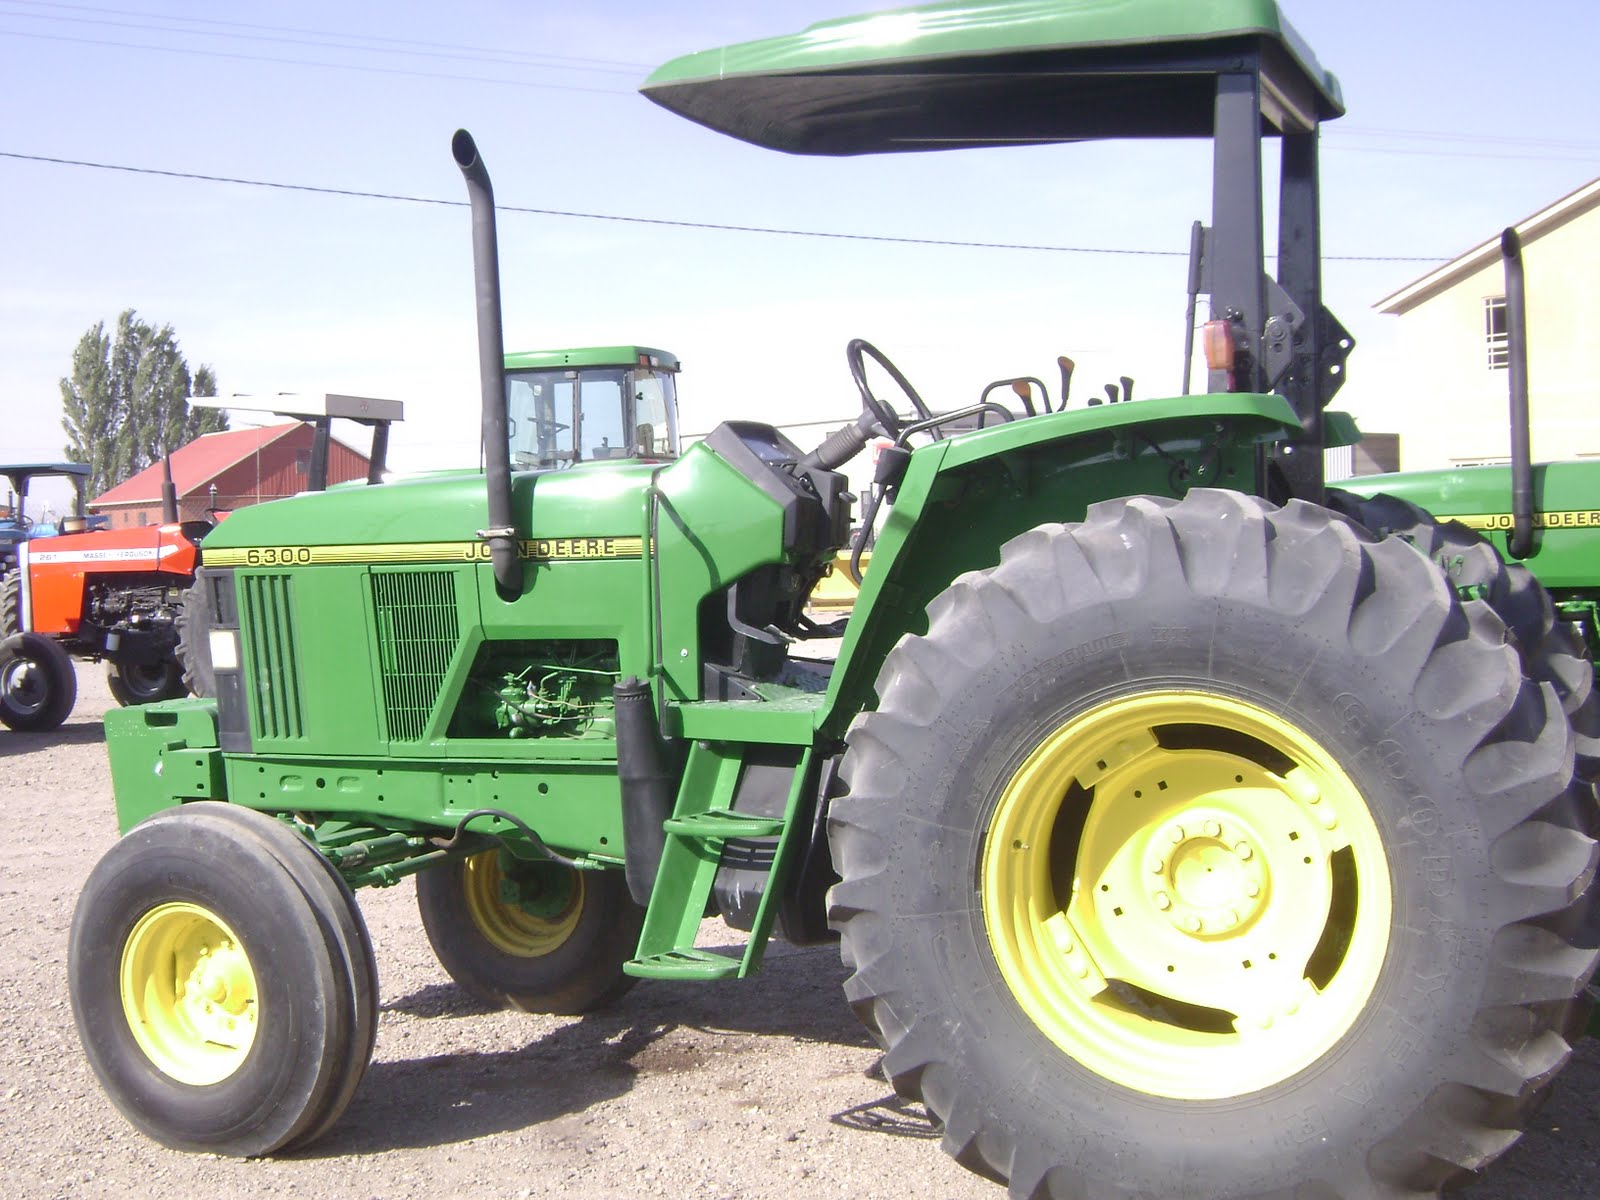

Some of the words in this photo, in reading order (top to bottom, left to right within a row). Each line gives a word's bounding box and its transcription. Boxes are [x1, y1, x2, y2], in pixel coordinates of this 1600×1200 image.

[1486, 514, 1541, 528] JON
[247, 548, 311, 563] 6300
[465, 542, 529, 559] JON
[537, 538, 614, 557] DEERE
